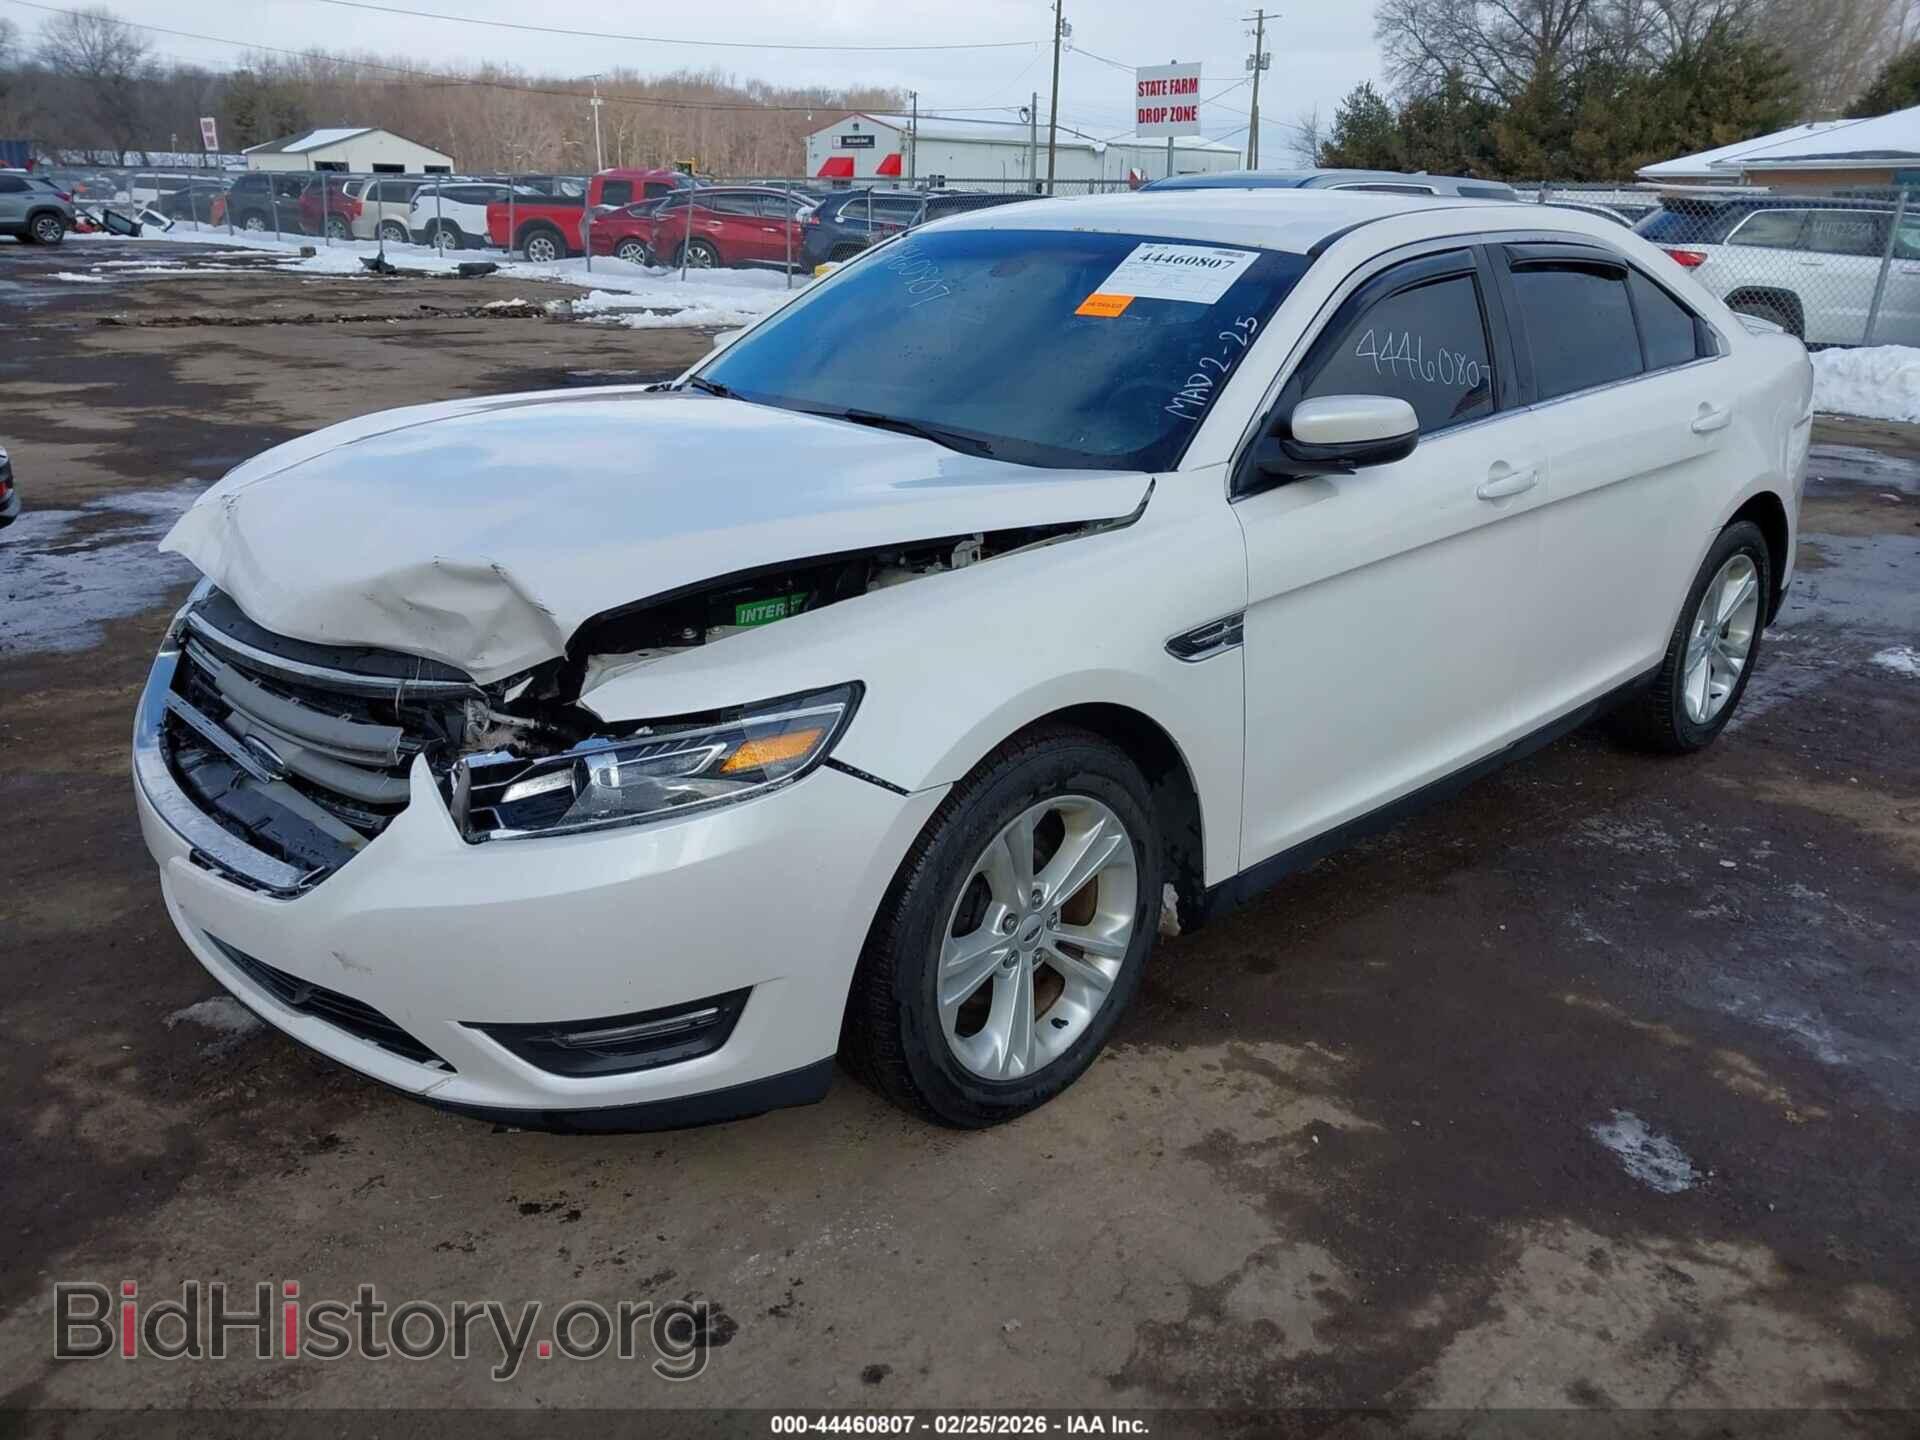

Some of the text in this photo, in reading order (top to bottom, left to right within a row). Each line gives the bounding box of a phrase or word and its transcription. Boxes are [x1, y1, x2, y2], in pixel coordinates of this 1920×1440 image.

[1138, 78, 1198, 97] STATE FARM
[1138, 105, 1197, 124] DROP ZONE
[1138, 252, 1236, 271] 44460807
[1164, 373, 1213, 420] MAD
[1199, 316, 1258, 373] 2-25
[1355, 329, 1491, 396] 44460807
